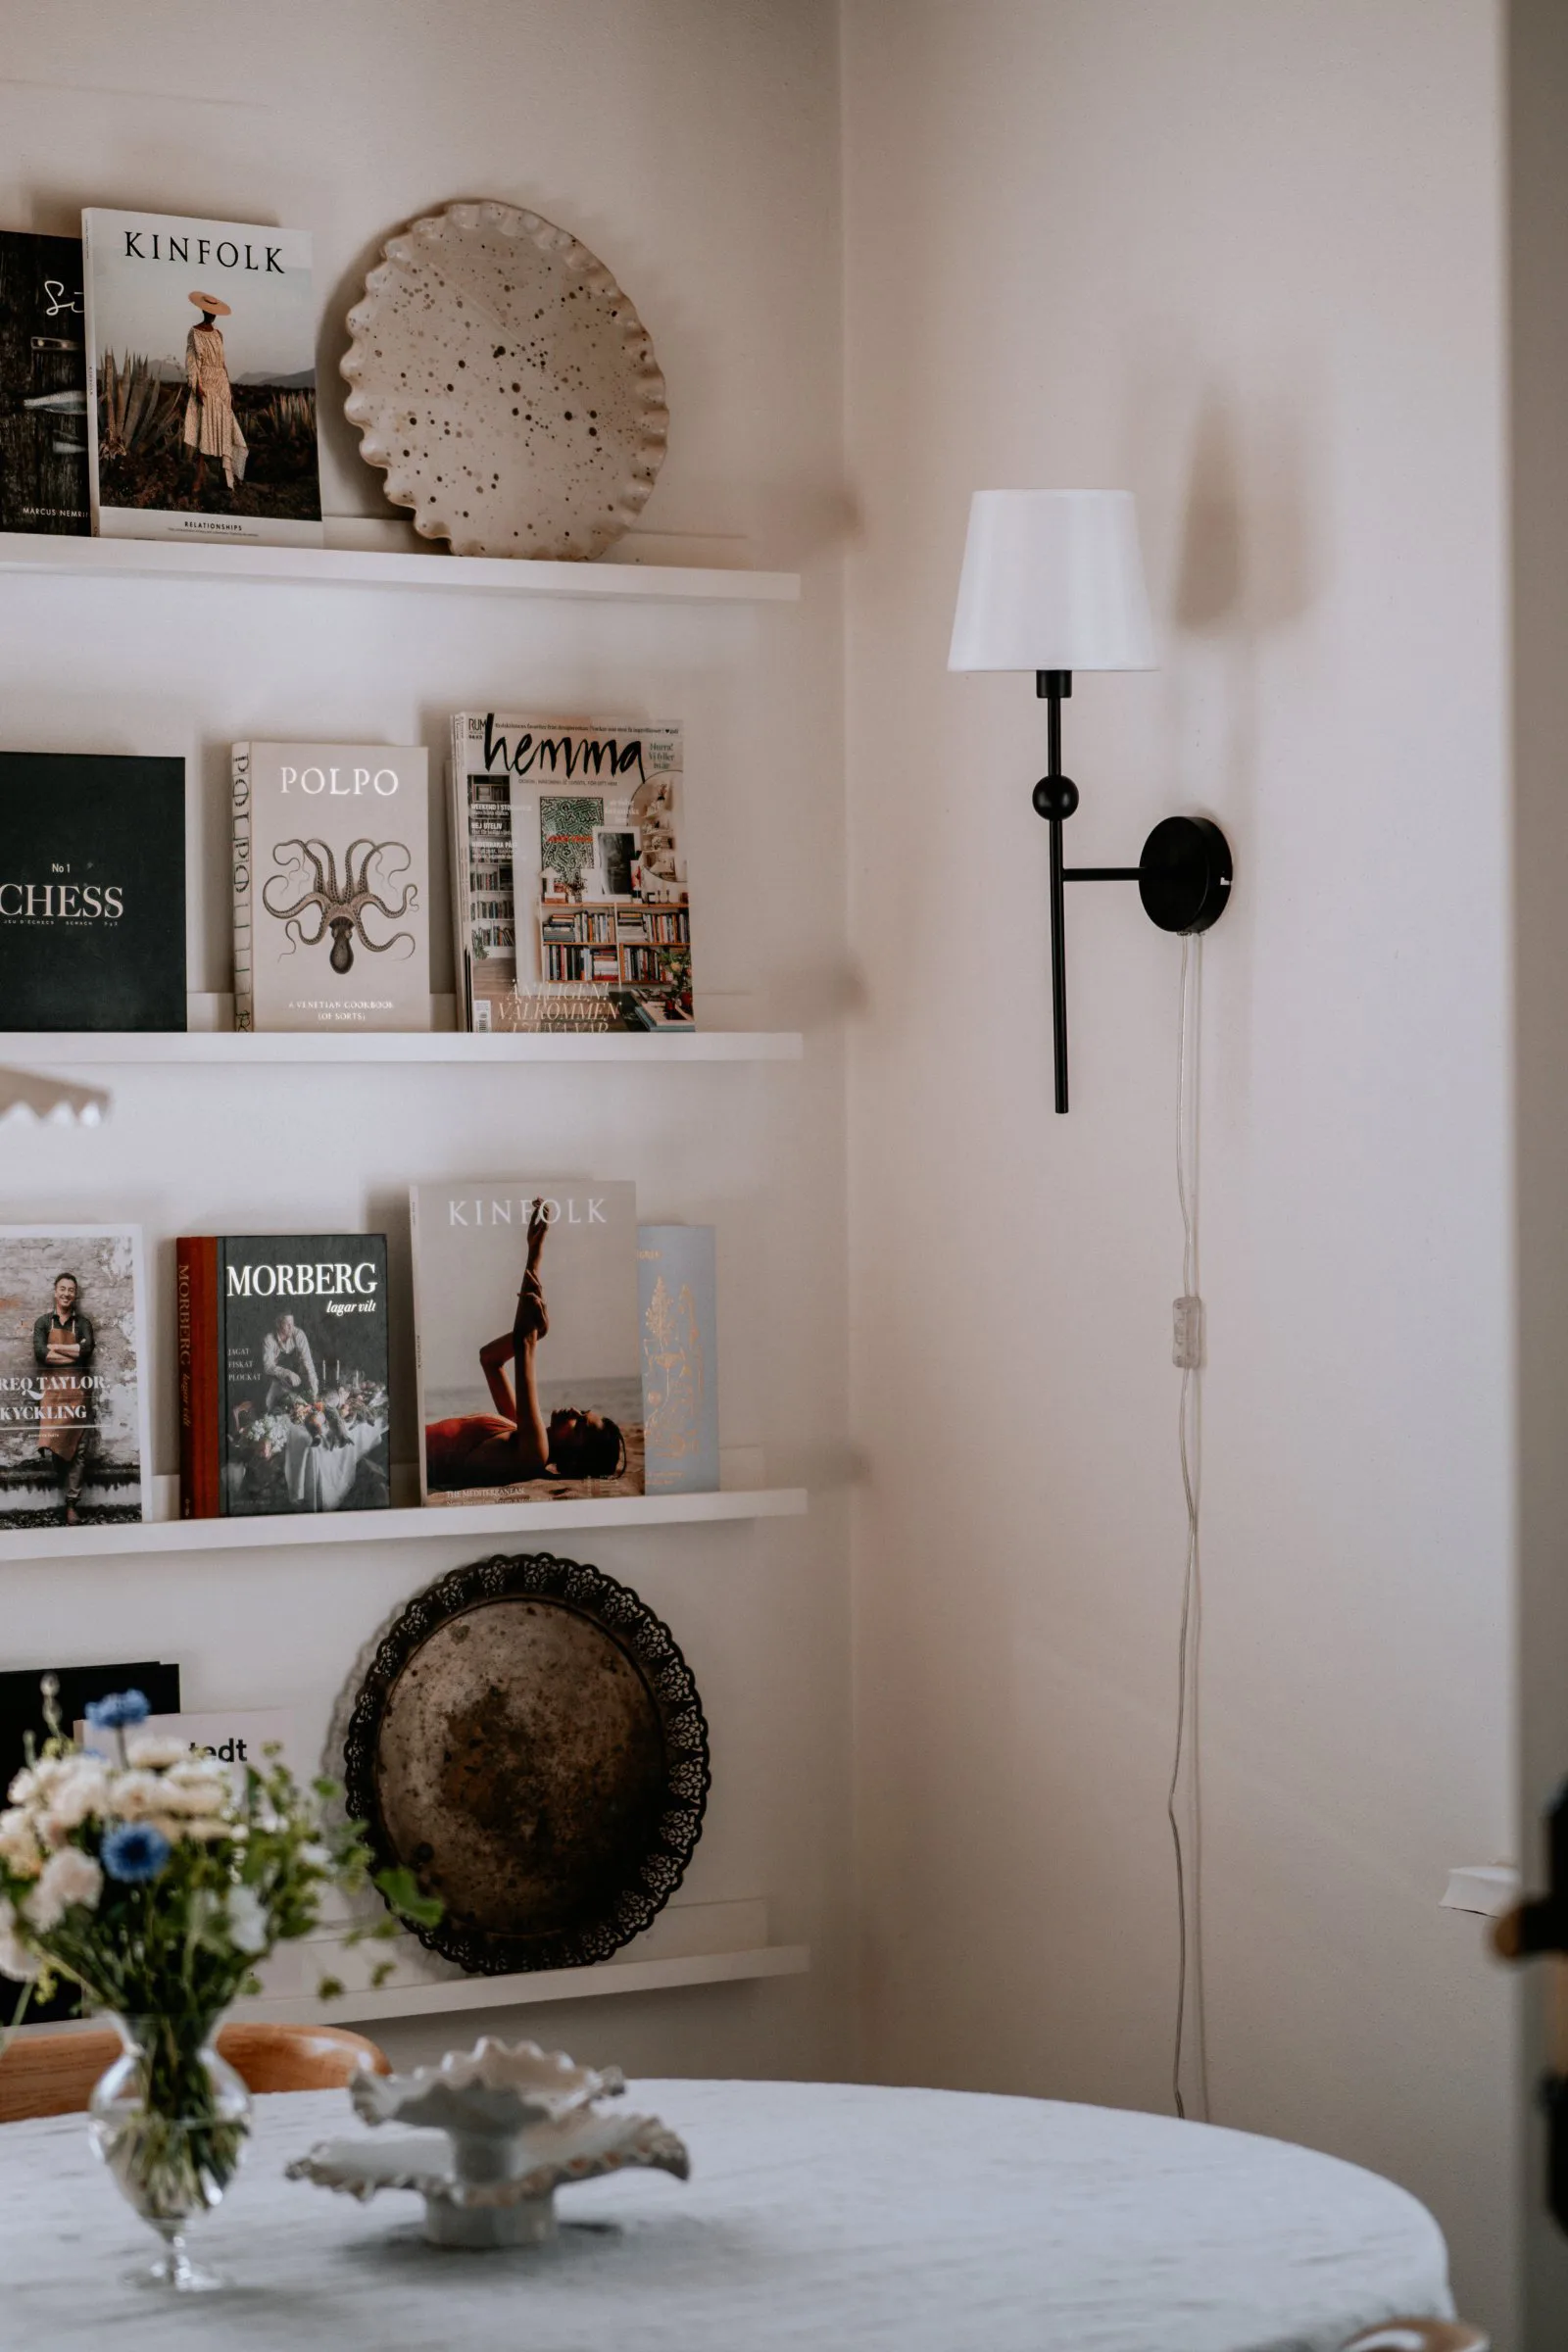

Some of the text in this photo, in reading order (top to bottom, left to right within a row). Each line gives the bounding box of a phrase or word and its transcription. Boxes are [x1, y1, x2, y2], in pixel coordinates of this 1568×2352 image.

[124, 231, 285, 274] KINFOLK
[23, 508, 56, 516] MARCUS
[184, 521, 242, 530] RELATIONSHIPS
[484, 712, 646, 784] hemma
[280, 766, 399, 796] POLPO
[232, 753, 250, 893] POLPO
[0, 883, 123, 918] CHESS
[296, 1001, 341, 1009] VENETIAN
[344, 1001, 394, 1009] COOKBOOK
[448, 1198, 608, 1226] KINFOLK
[226, 1262, 378, 1297] MORBERG
[326, 1299, 377, 1316] lagar vilt
[228, 1348, 249, 1356] JAGAT
[36, 1375, 111, 1391] TAYLOR.
[0, 1405, 87, 1420] KYCKLING
[447, 1490, 461, 1498] THE
